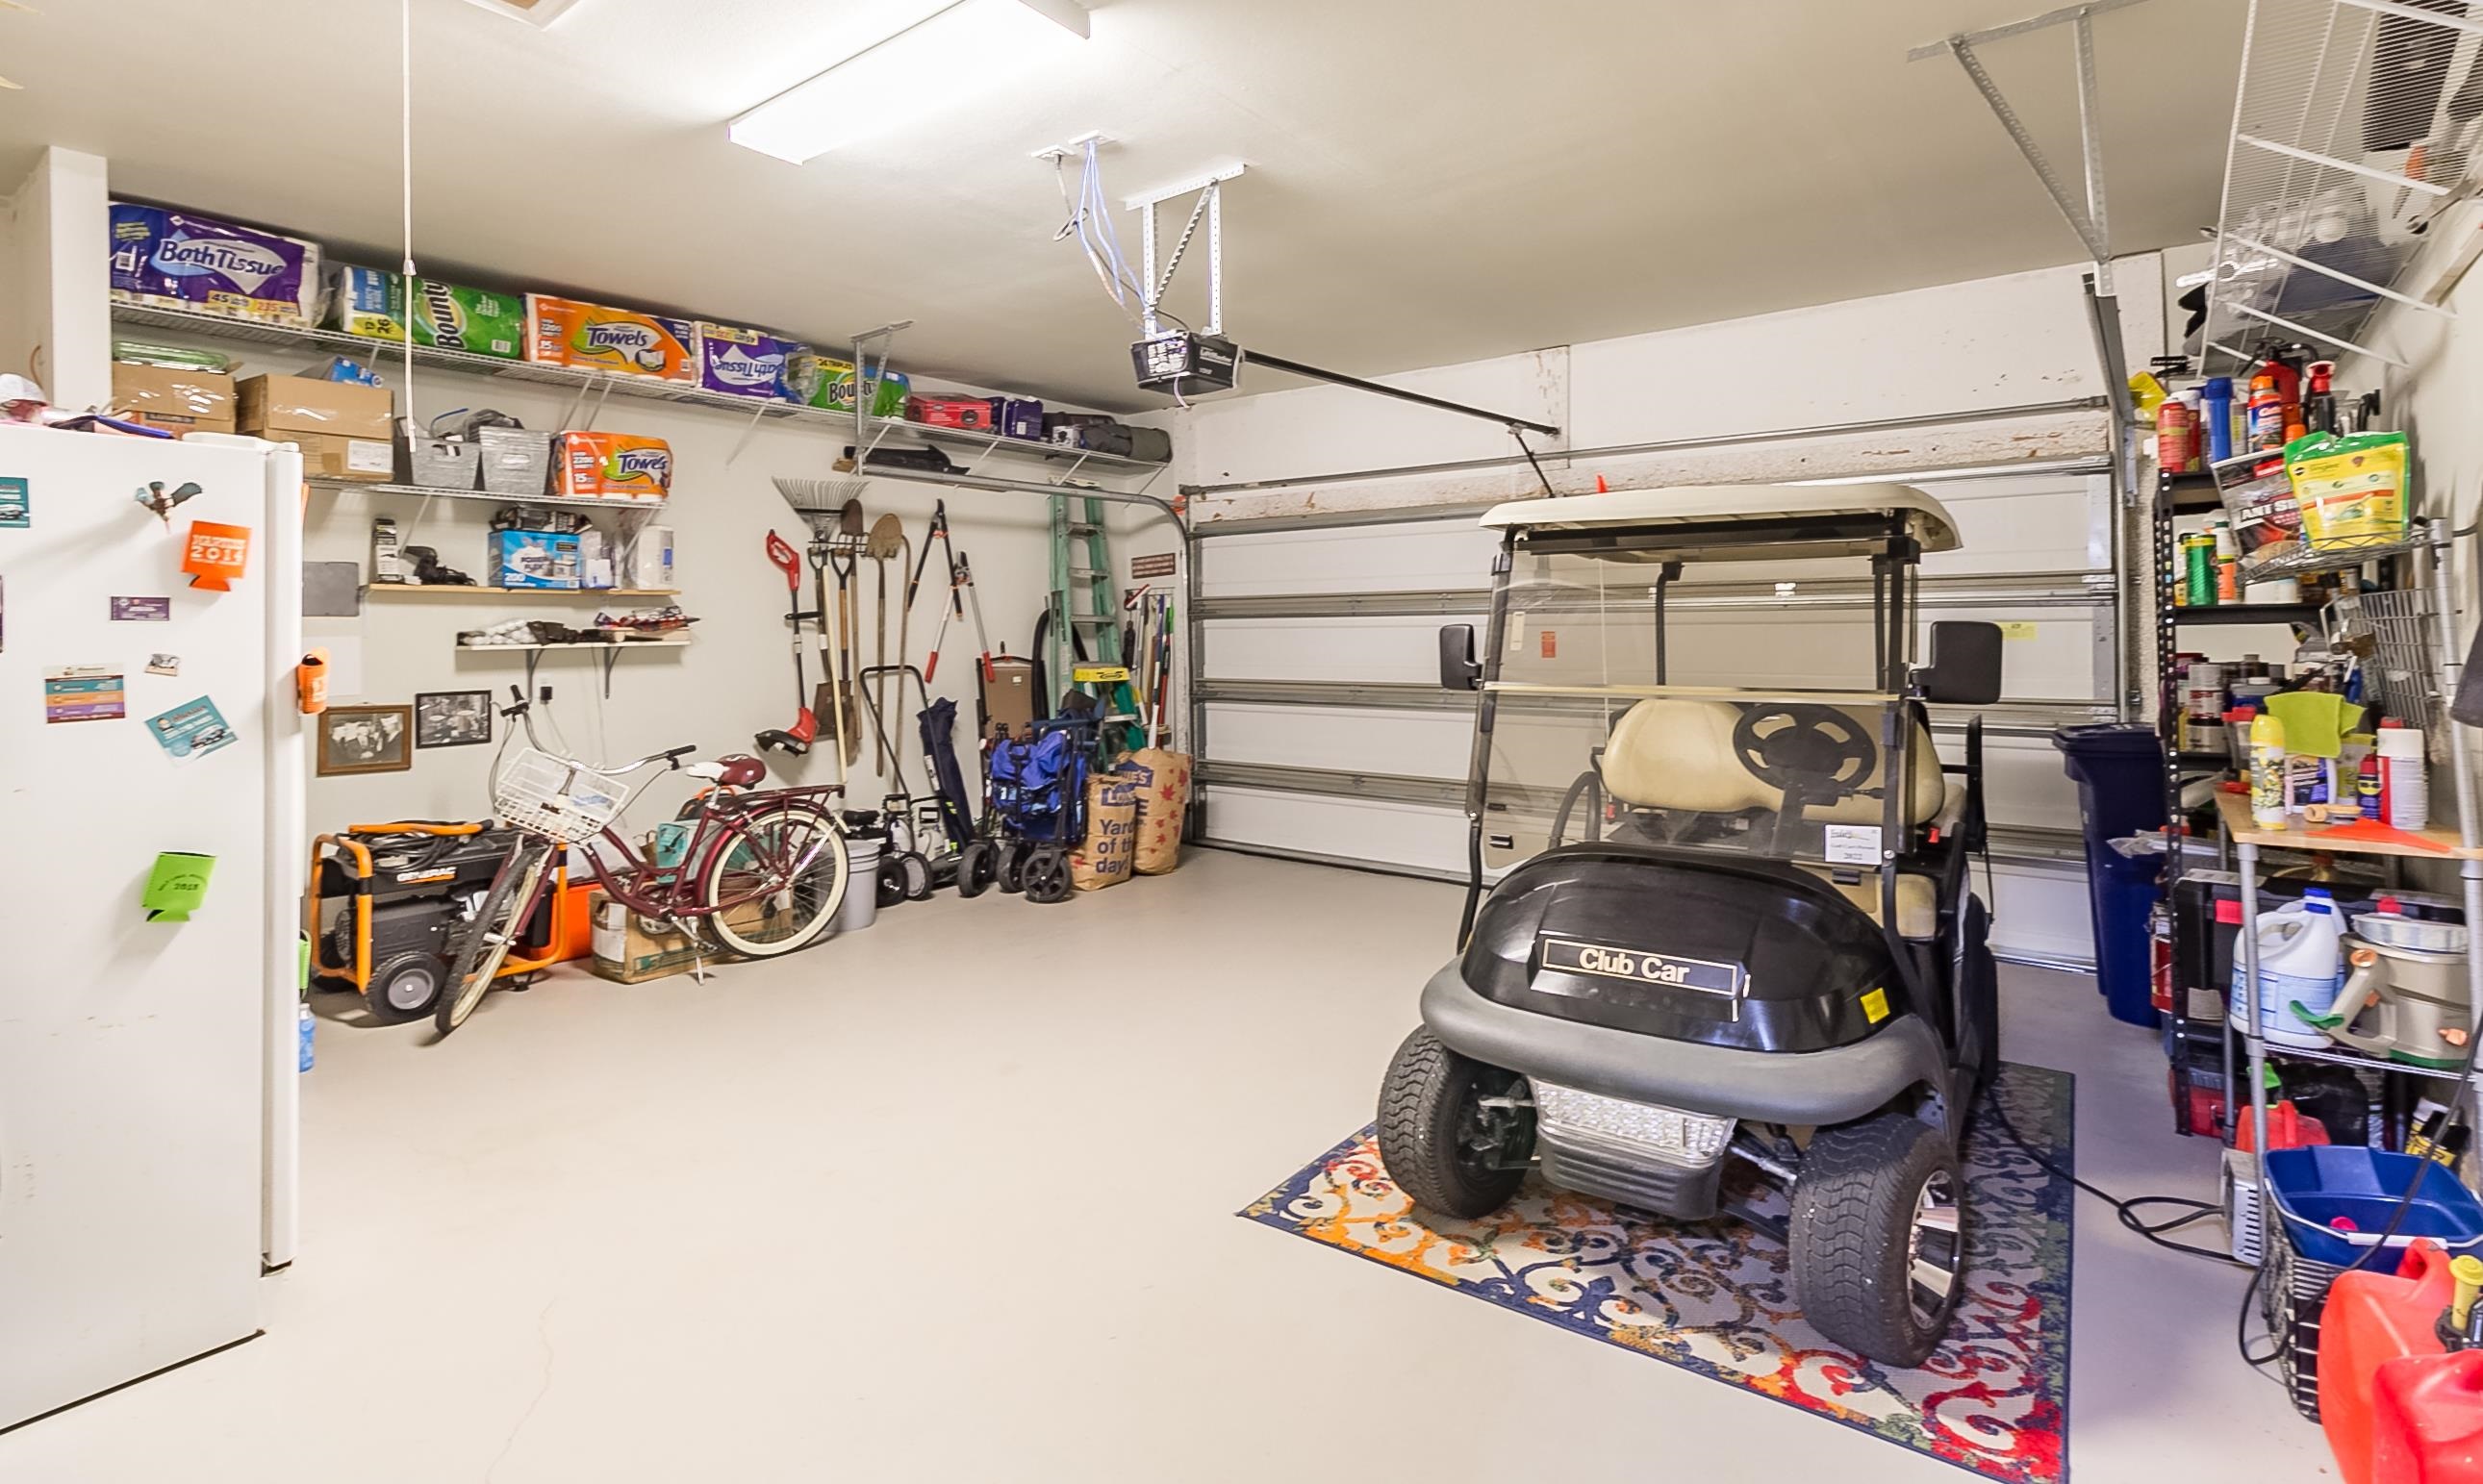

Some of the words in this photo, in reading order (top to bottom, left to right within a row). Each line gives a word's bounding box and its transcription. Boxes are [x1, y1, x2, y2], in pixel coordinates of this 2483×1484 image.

[212, 292, 229, 303] 45
[422, 278, 468, 349] Bounty
[377, 318, 391, 334] 26
[586, 327, 647, 347] Towels
[1097, 838, 1117, 854] of
[1122, 837, 1134, 854] th
[1579, 947, 1634, 975] Club
[1640, 956, 1690, 983] Car
